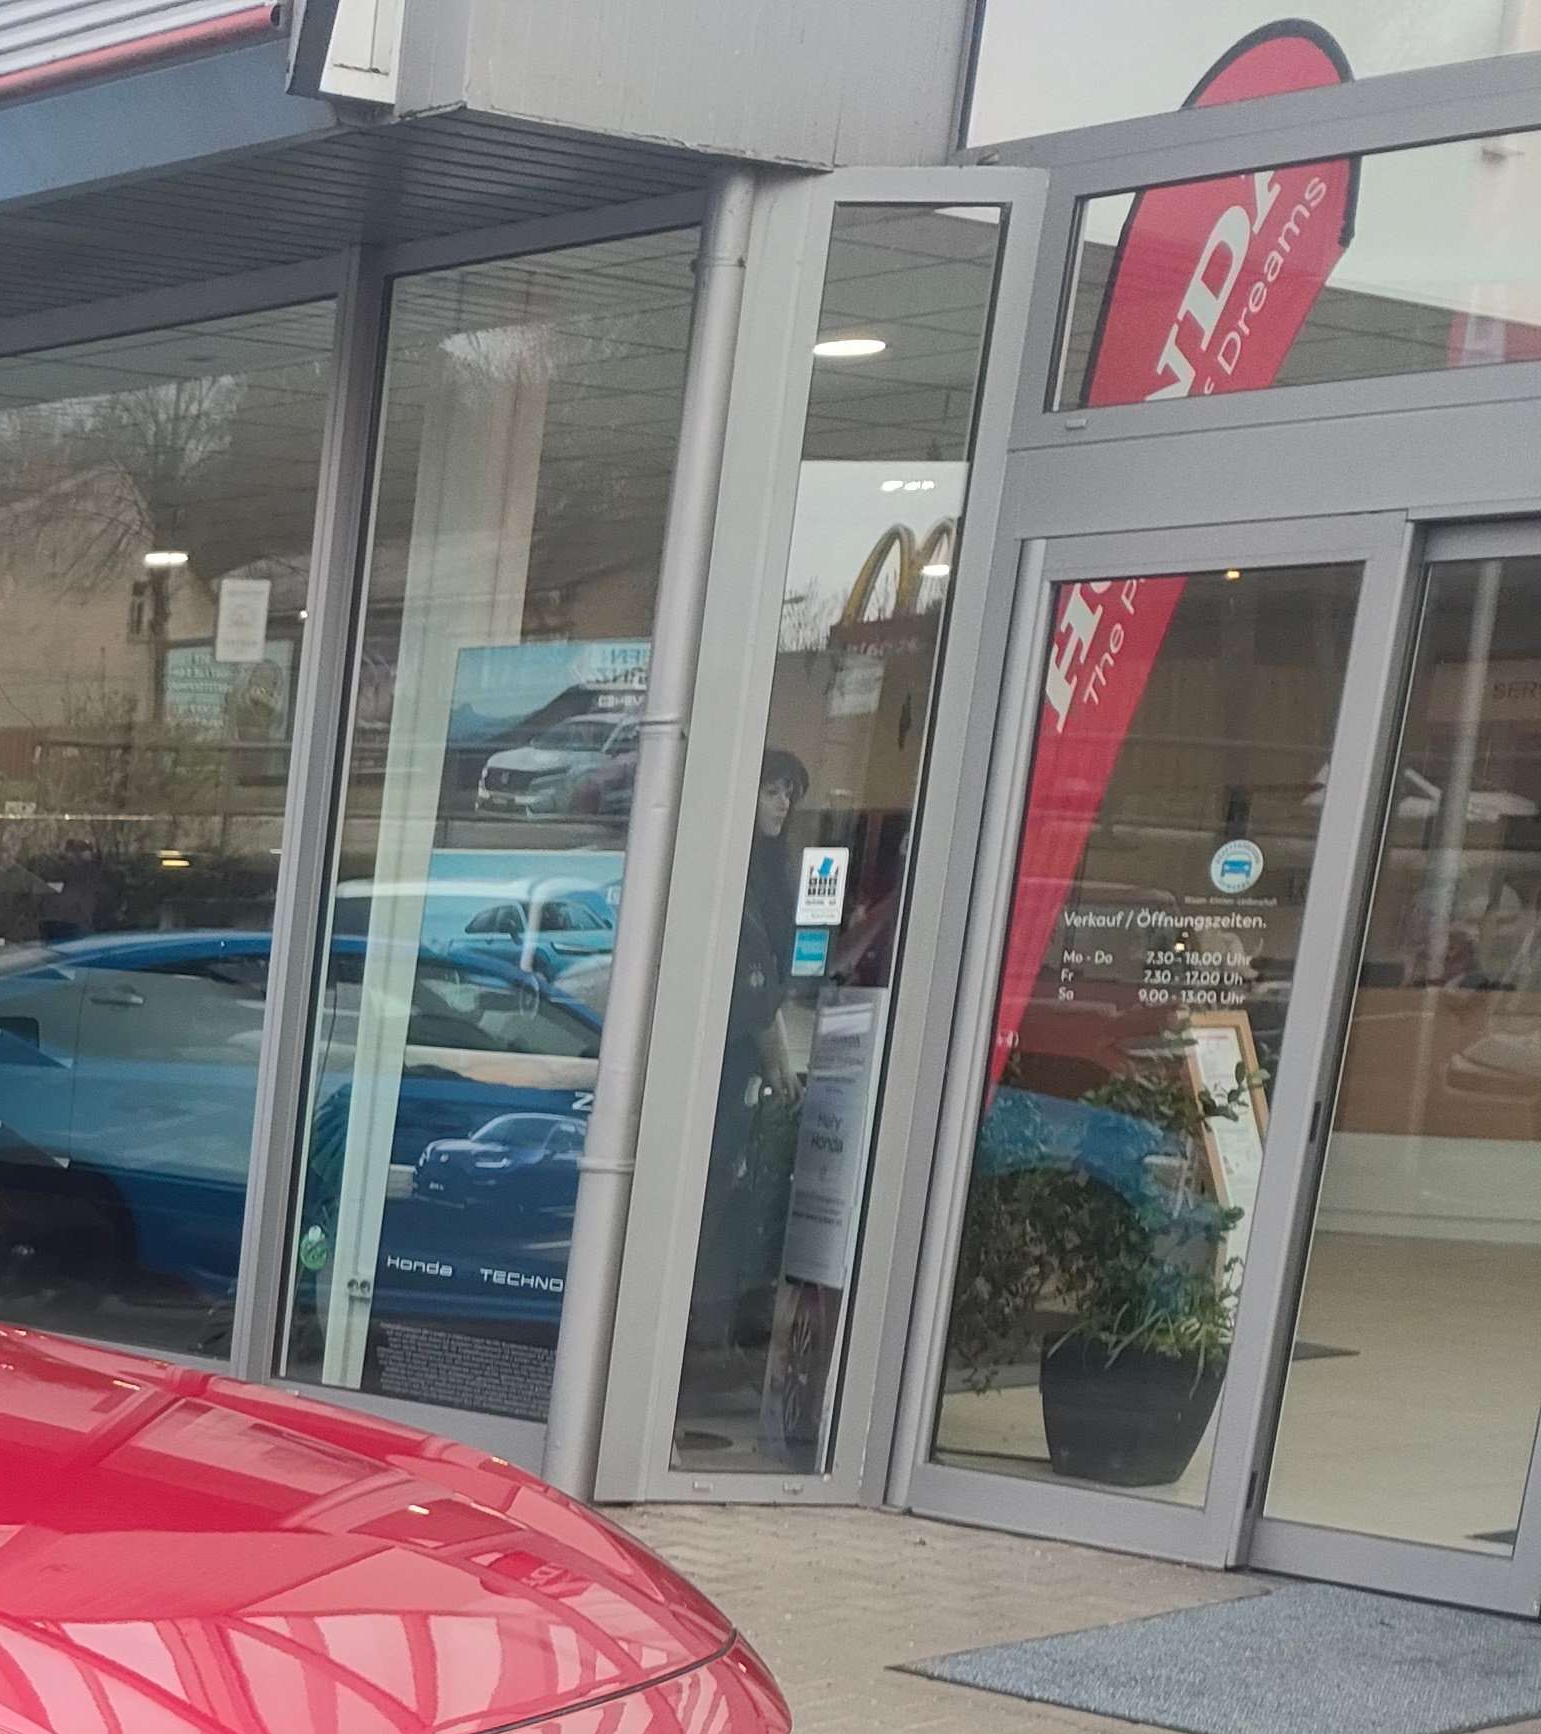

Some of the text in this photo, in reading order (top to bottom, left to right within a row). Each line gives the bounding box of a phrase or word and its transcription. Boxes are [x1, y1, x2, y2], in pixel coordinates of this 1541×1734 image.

[1217, 176, 1328, 376] Dreams
[1064, 911, 1125, 928] Verkauf
[1137, 908, 1267, 930] Öffnungszeiten.
[1063, 951, 1083, 964] Mo
[1094, 952, 1113, 965] Do
[1061, 970, 1074, 983] Fr
[1058, 988, 1074, 1001] Sa
[386, 1254, 453, 1278] Honda
